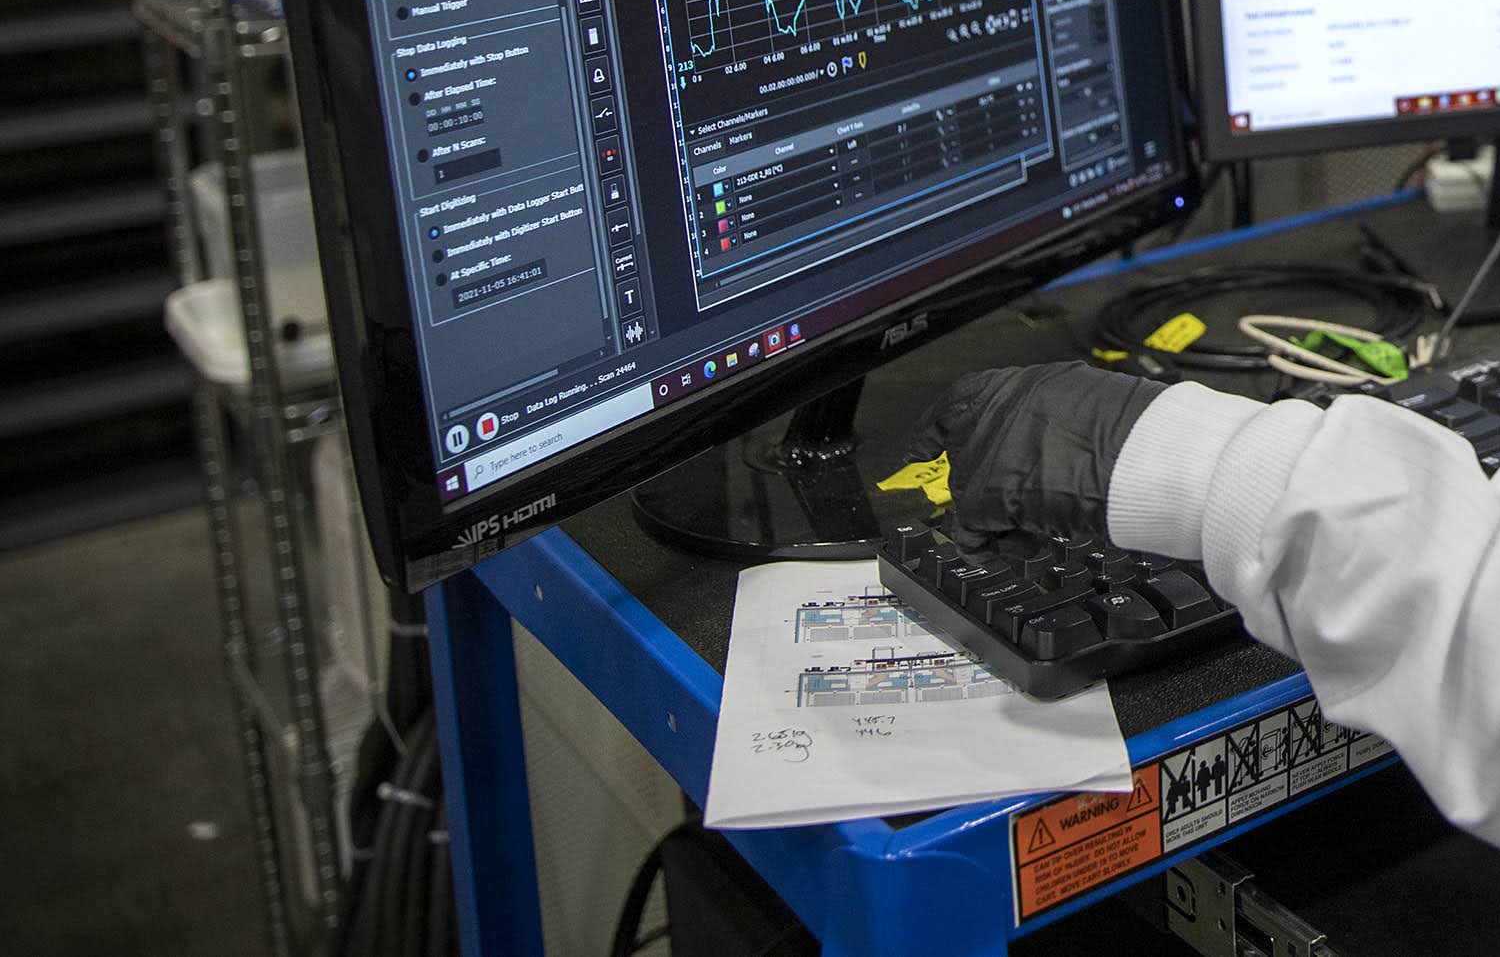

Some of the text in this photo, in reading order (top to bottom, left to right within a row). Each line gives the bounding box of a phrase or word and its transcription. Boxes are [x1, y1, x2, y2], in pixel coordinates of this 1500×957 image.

[412, 5, 439, 16] Manual
[396, 36, 467, 58] Stop Data Logging
[420, 45, 529, 78] Immediately with Stop Button
[678, 61, 694, 73] 213
[424, 77, 497, 101] After Elapsed Time:
[698, 108, 768, 135] Select Channels/Markers
[432, 146, 451, 158] After
[460, 137, 486, 151] Scans:
[694, 132, 752, 156] Channels Markers
[712, 165, 727, 175] Color
[420, 194, 476, 217] Start Digitizing
[739, 194, 752, 204] None
[443, 214, 490, 235] Immediately
[491, 208, 507, 220] with
[508, 202, 525, 214] Data
[526, 195, 550, 211] Logger
[551, 189, 569, 201] Start
[741, 212, 755, 222] None
[447, 208, 583, 257] Immediately with Digitizer Start Button
[744, 230, 757, 240] None
[450, 253, 512, 281] At Specific Time:
[458, 267, 541, 302] 2021-11-05 16:41:01
[501, 362, 636, 425] Stop Data Log Scan 24464
[489, 432, 563, 474] Type here to search
[503, 493, 556, 530] HDMI
[1059, 797, 1120, 831] WARNING
